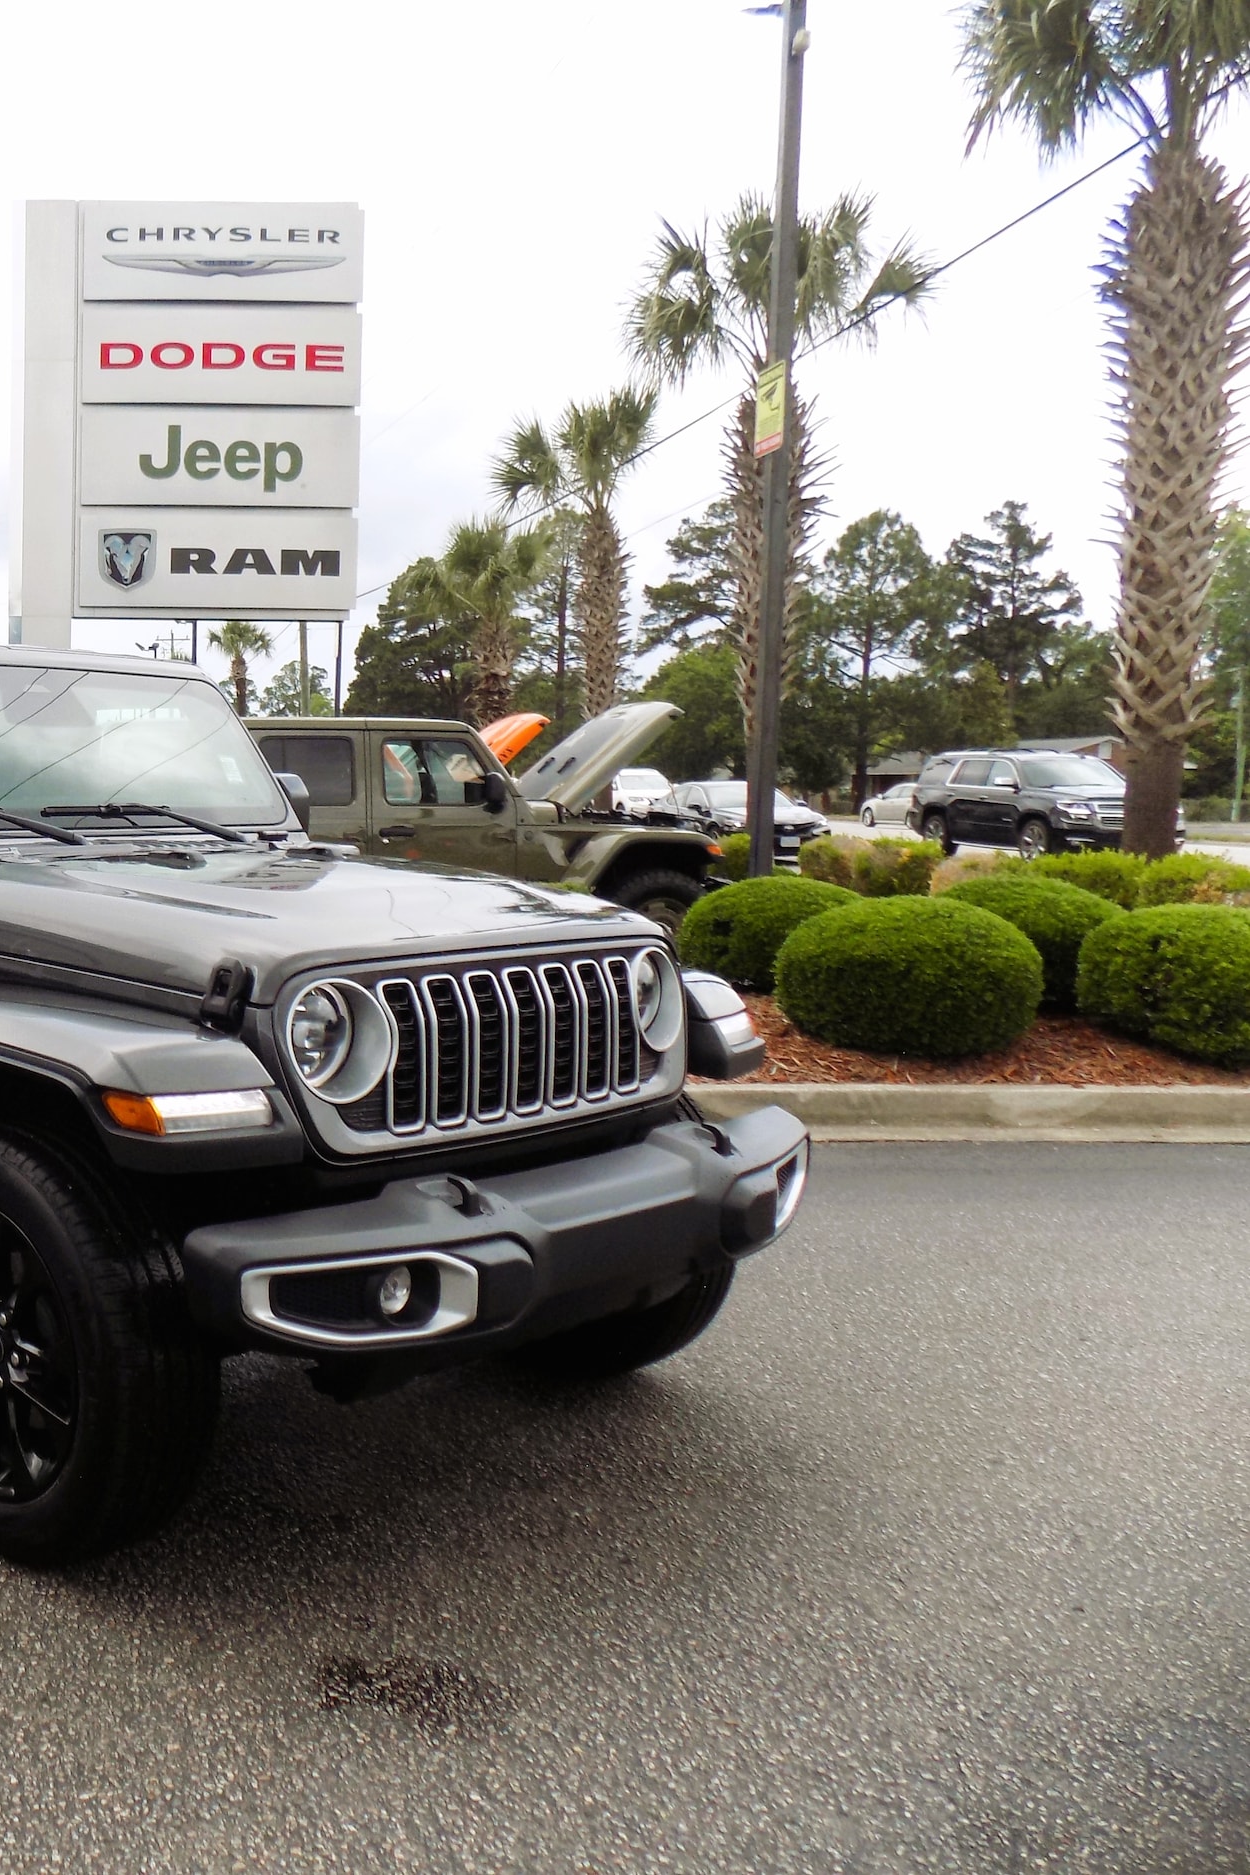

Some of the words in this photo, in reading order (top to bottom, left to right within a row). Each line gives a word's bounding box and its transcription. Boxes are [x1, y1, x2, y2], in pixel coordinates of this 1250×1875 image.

[106, 227, 340, 244] CHRYSLER
[100, 342, 345, 372] DODGE
[139, 424, 303, 492] Jeep
[170, 547, 340, 576] RAM
